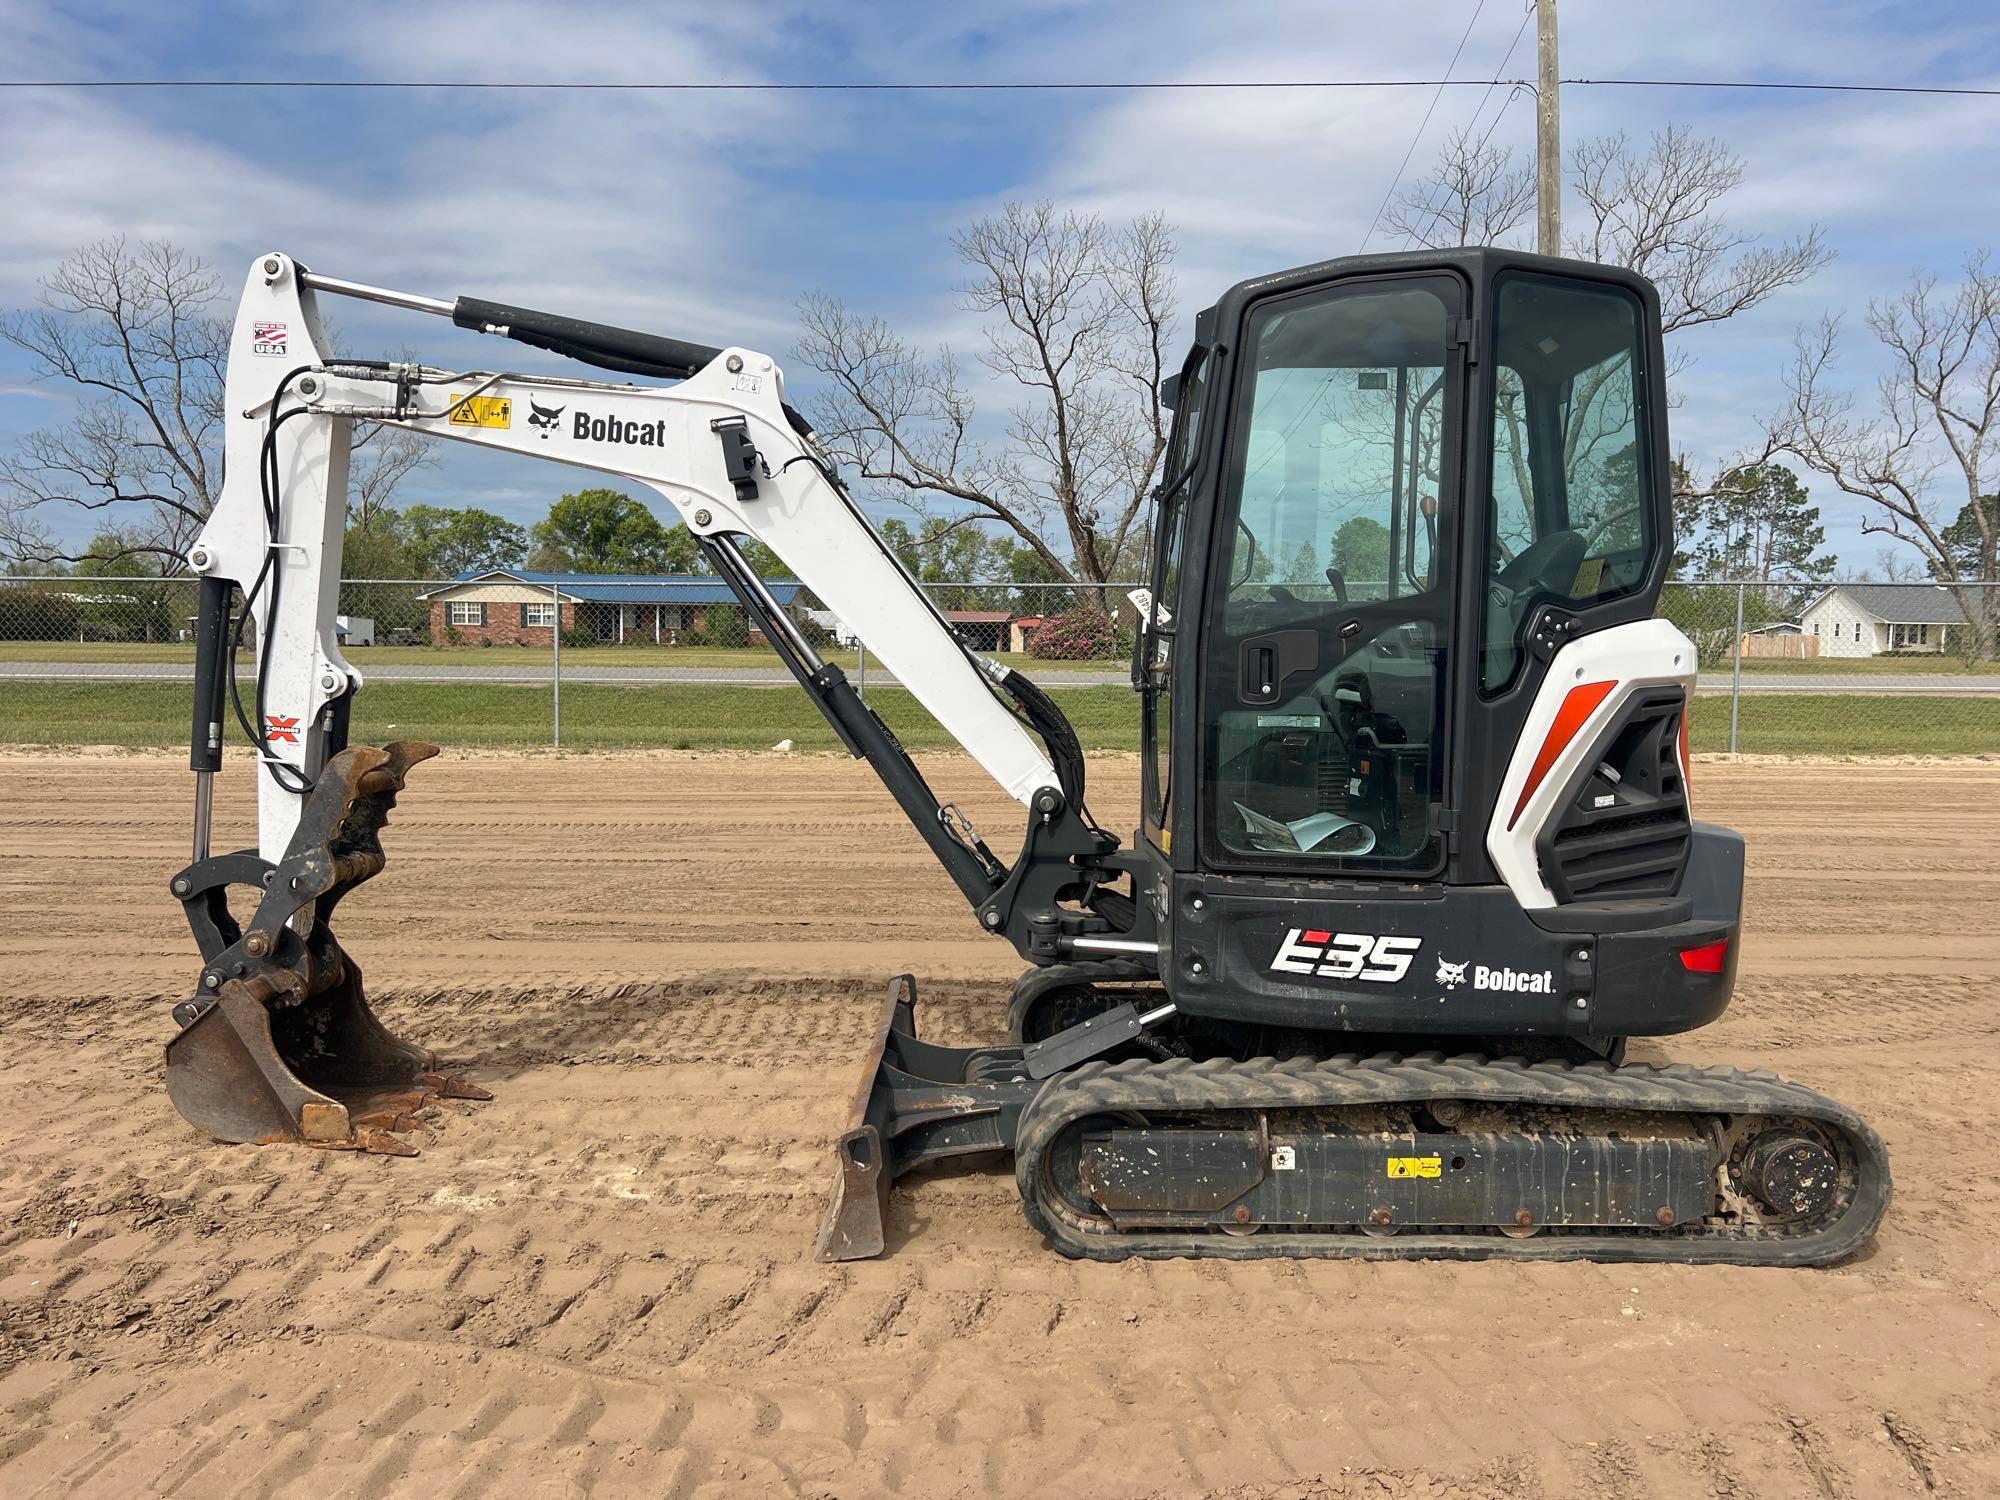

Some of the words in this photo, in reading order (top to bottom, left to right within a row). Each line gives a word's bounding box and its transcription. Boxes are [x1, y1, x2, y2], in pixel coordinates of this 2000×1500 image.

[255, 345, 284, 354] USA
[573, 411, 666, 447] Bobcat
[1270, 928, 1422, 982] E35
[1473, 965, 1553, 994] Bobcat
